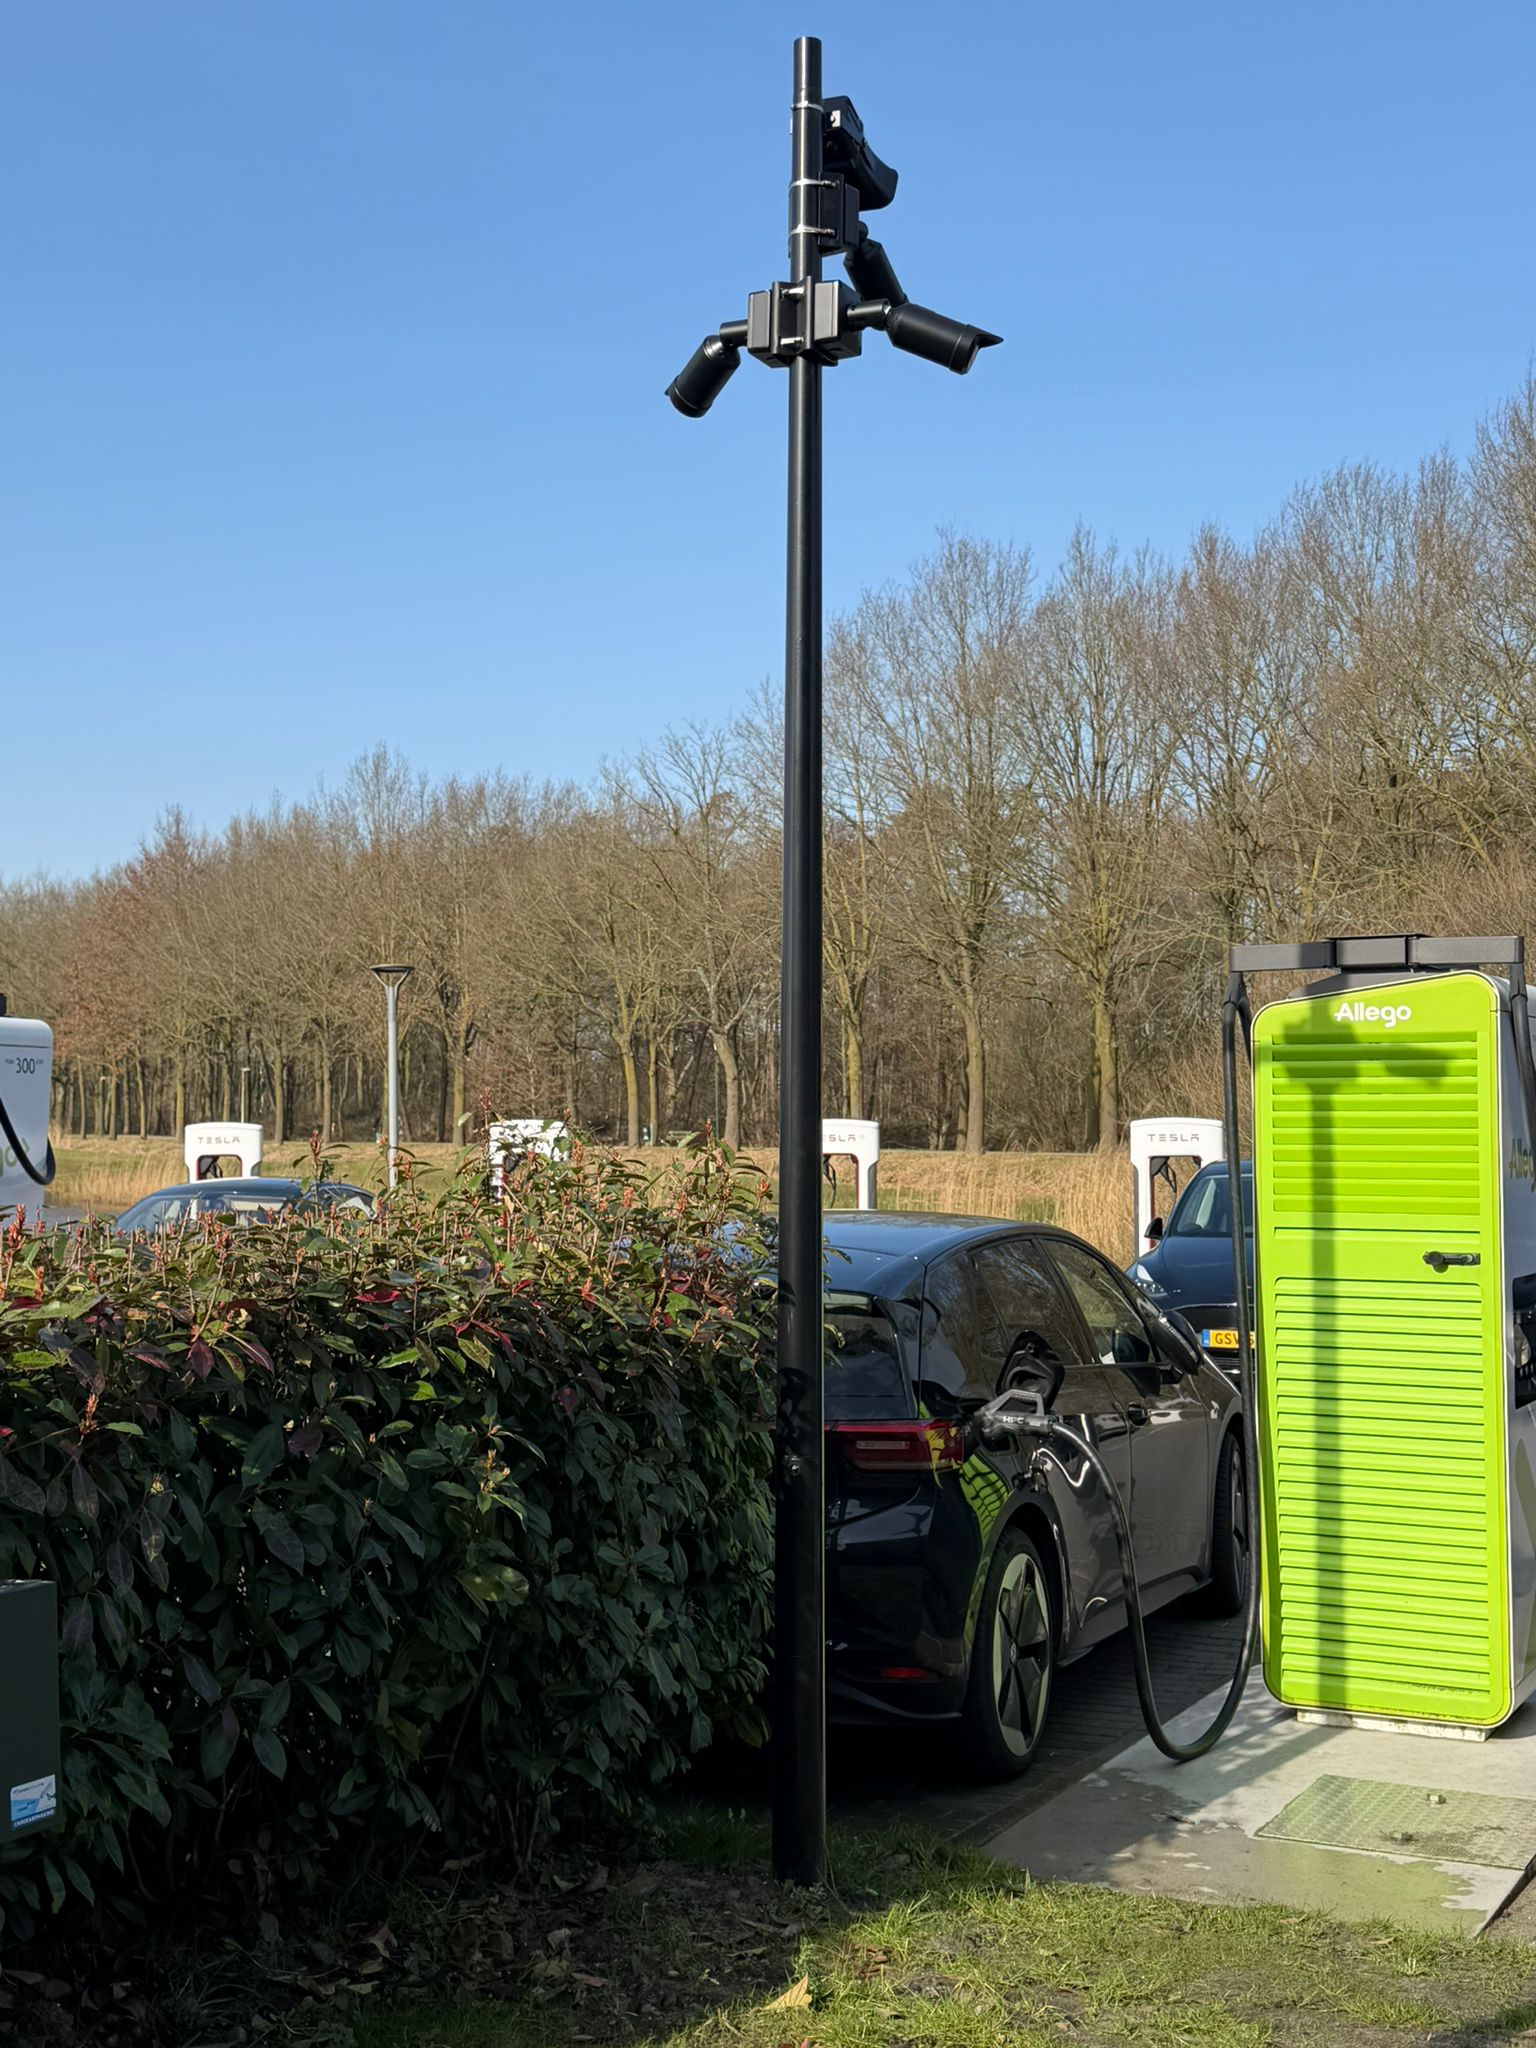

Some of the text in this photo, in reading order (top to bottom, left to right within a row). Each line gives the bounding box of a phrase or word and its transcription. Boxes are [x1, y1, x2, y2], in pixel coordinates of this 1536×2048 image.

[1334, 1002, 1412, 1028] Allego
[16, 1057, 35, 1074] 300
[198, 1136, 240, 1144] TESLA
[1147, 1133, 1200, 1142] TESLA
